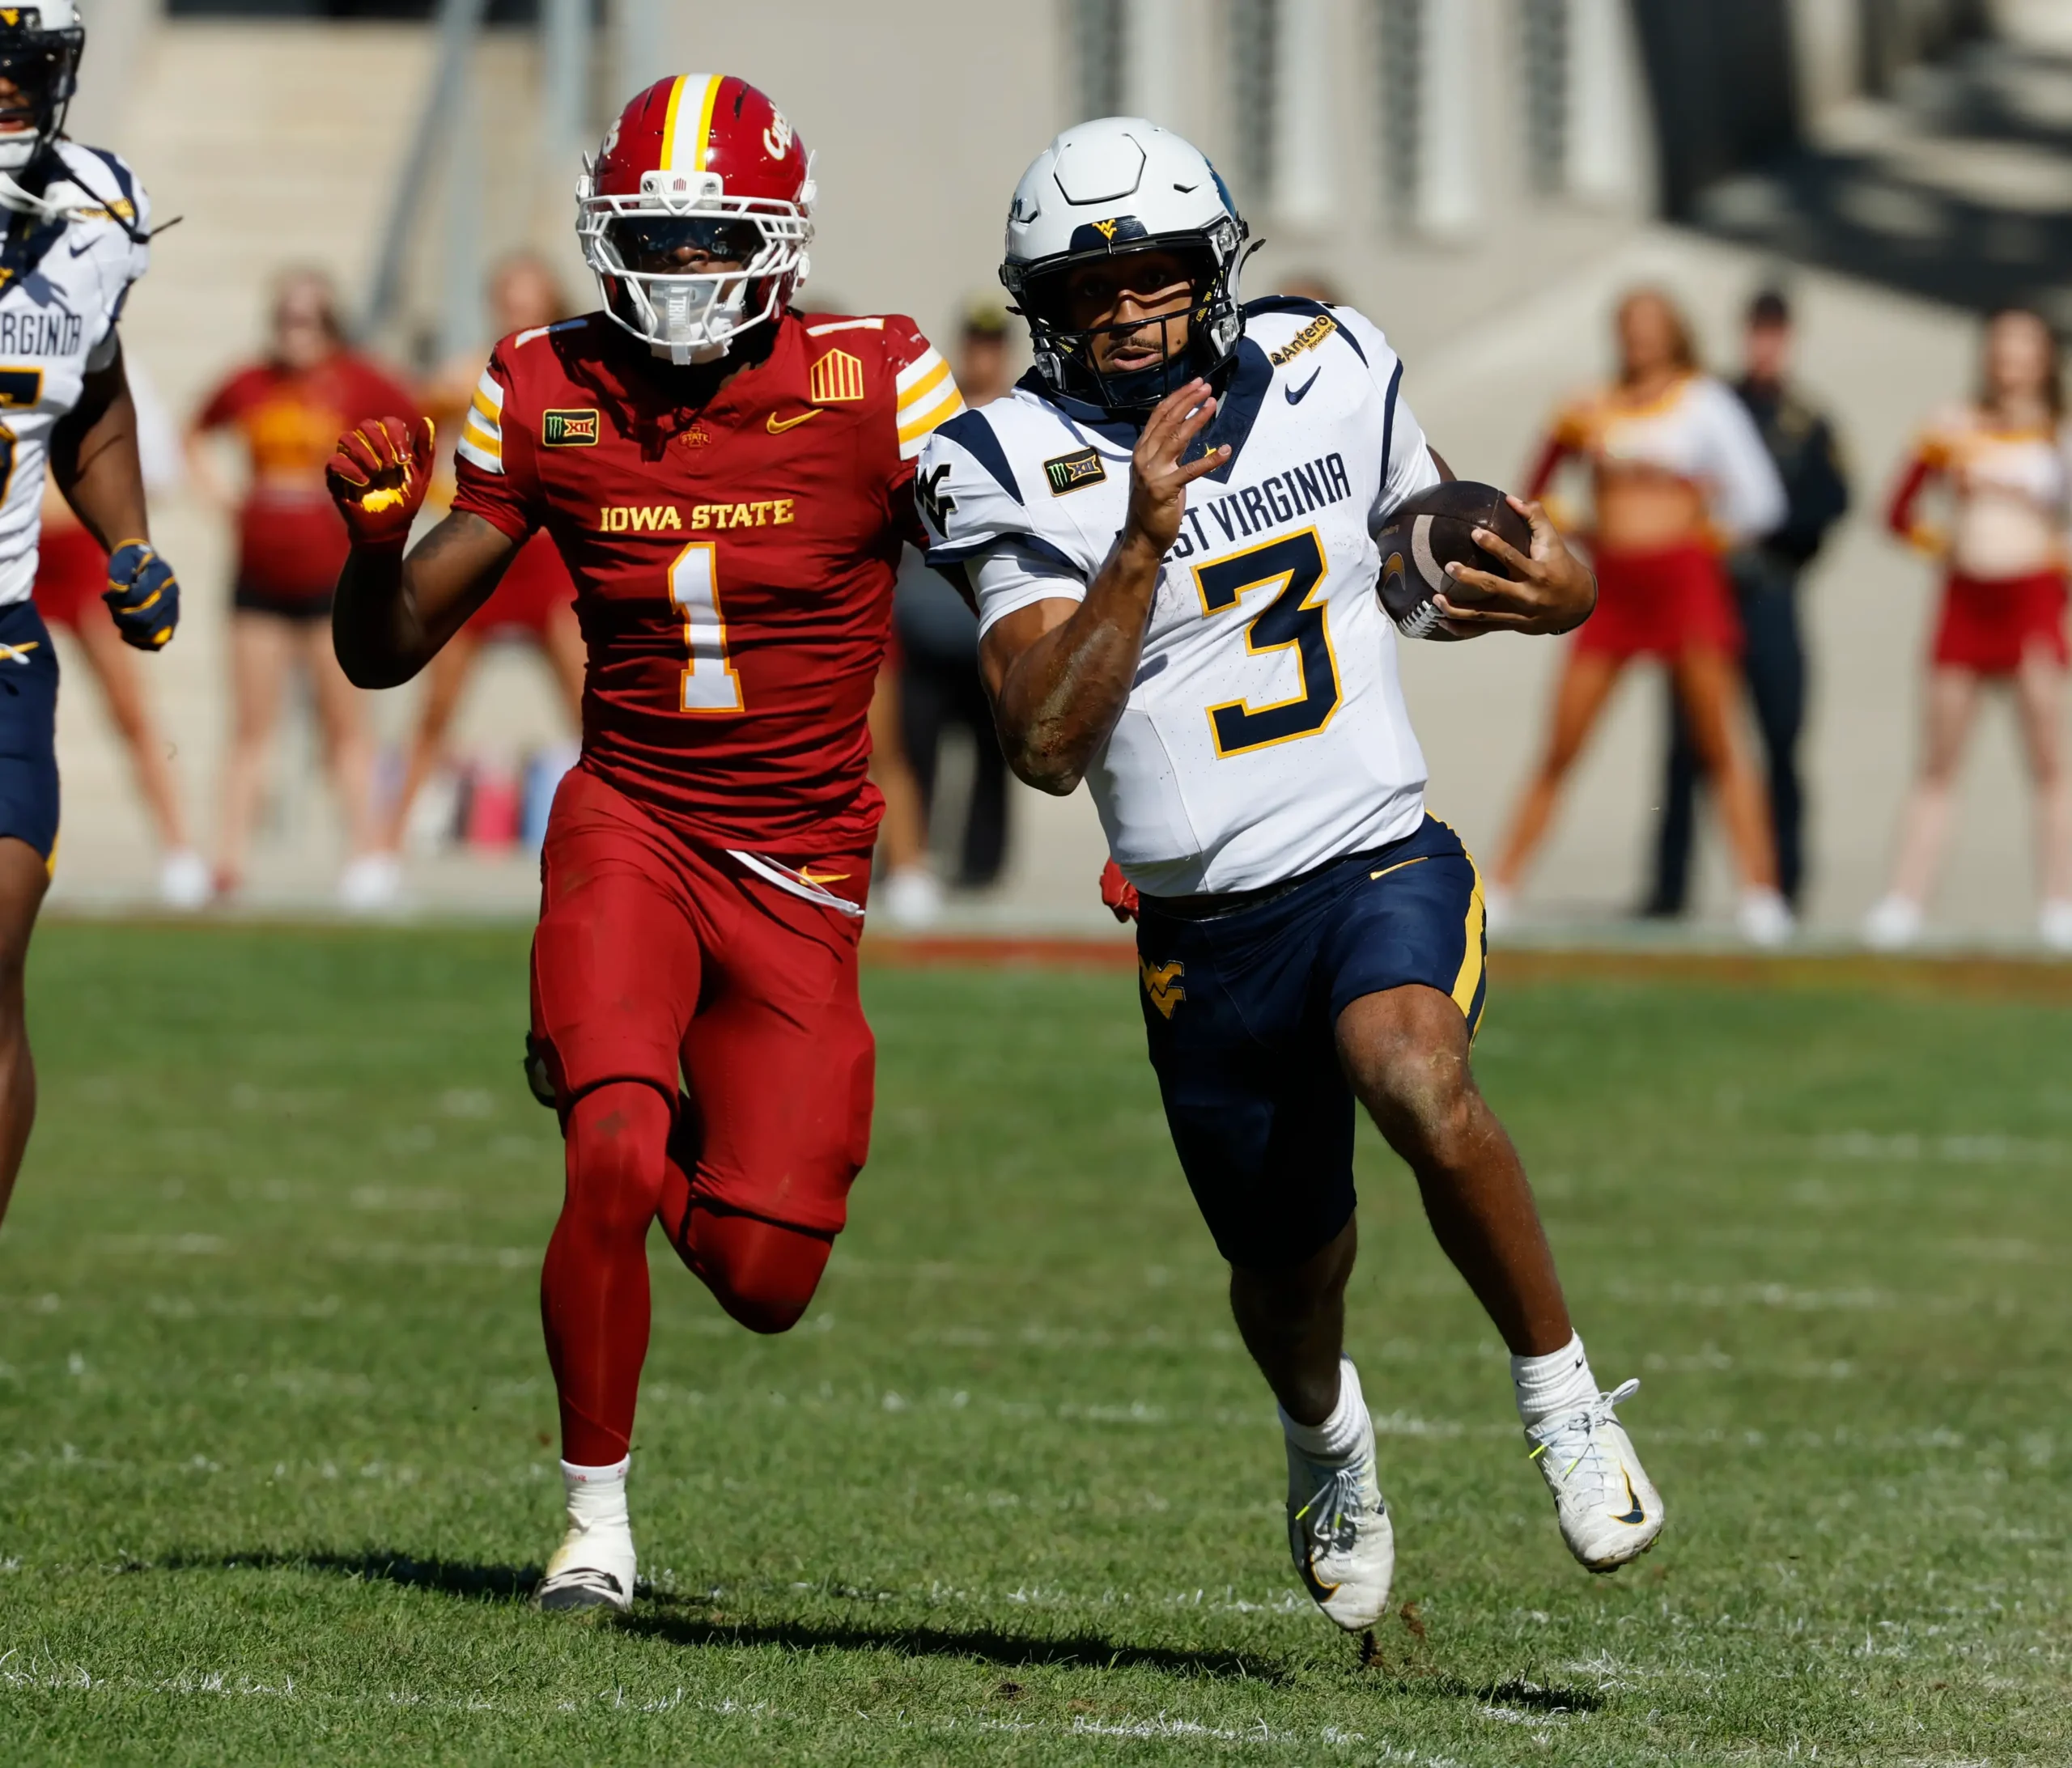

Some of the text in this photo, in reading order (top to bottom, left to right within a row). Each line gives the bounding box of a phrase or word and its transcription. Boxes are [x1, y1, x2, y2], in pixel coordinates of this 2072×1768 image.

[1280, 316, 1329, 361] Antero
[599, 498, 795, 532] IOWA STATE
[1207, 452, 1352, 542] VIRGINIA
[668, 541, 745, 713] 1
[1190, 524, 1344, 760] 3
